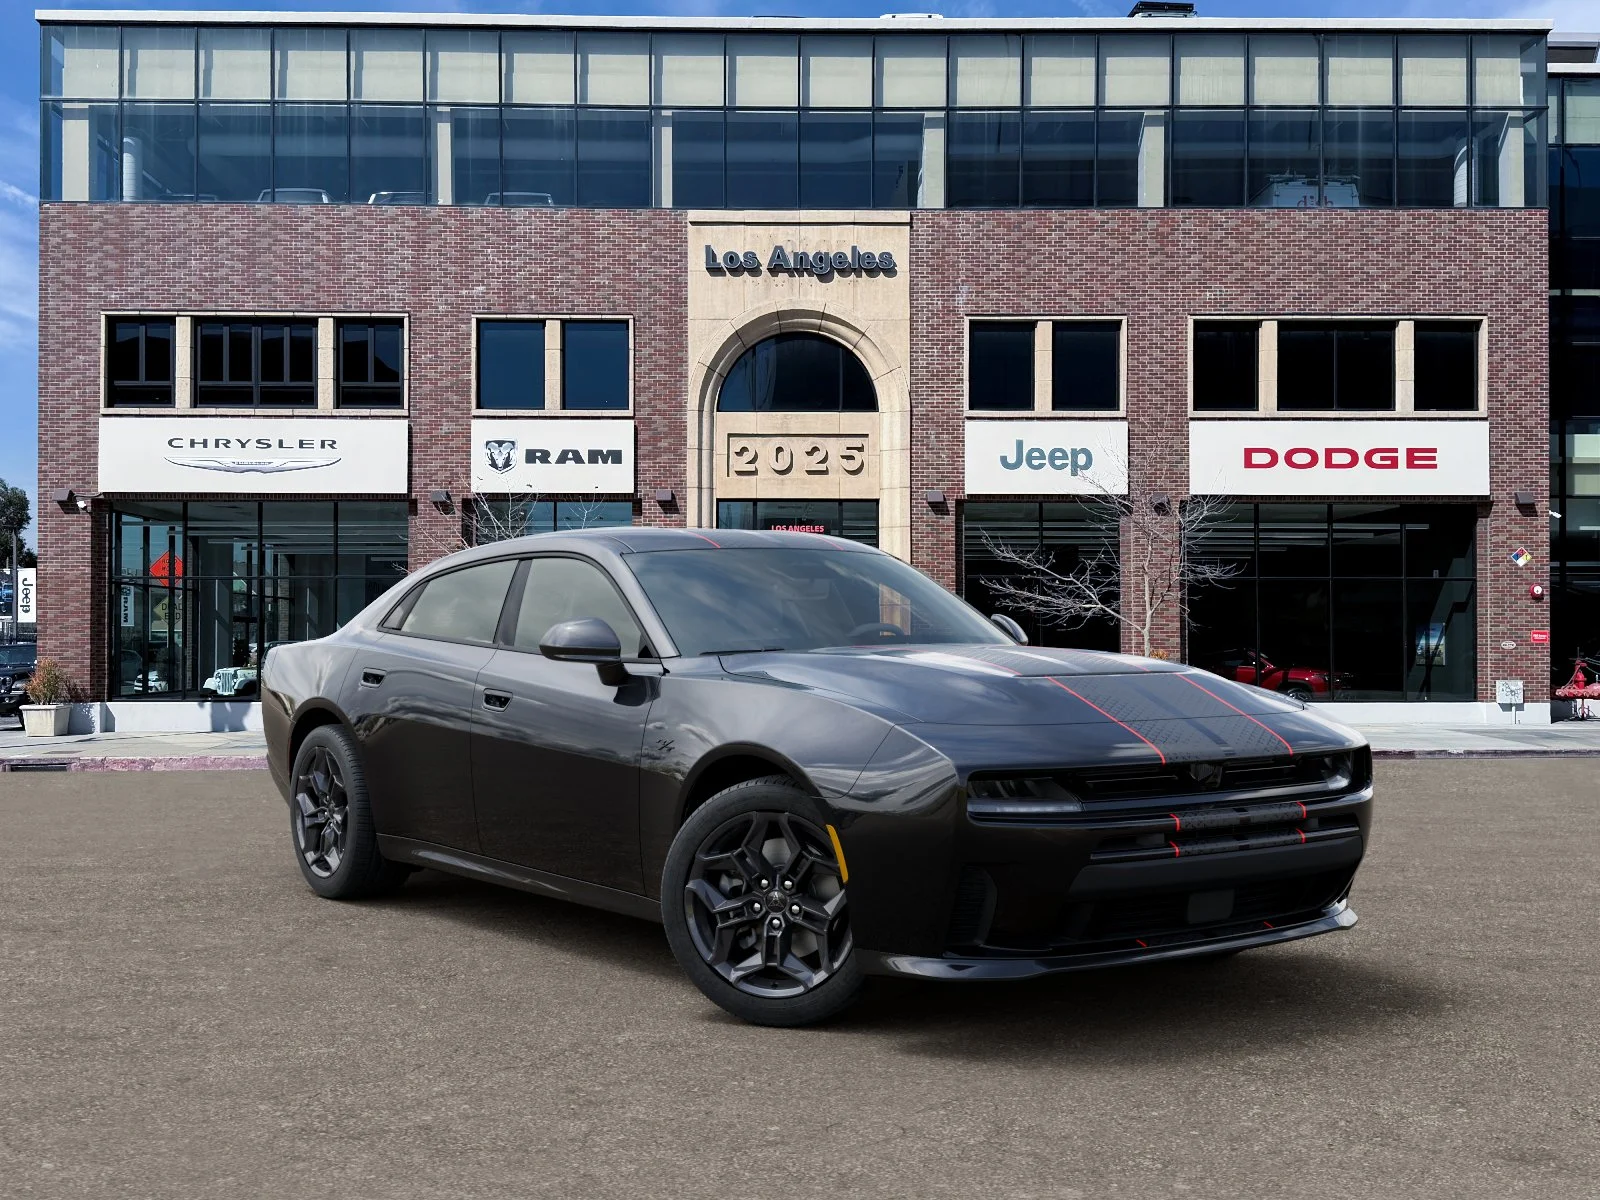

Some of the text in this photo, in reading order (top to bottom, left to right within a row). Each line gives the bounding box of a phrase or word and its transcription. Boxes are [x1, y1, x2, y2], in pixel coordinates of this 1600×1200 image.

[704, 244, 896, 276] Los Angeles
[167, 437, 338, 450] CHRYSLER
[525, 448, 623, 465] RAM
[733, 441, 864, 474] 2025
[1000, 439, 1093, 476] Jeep
[1243, 447, 1438, 470] DODGE
[20, 577, 34, 614] Jeep
[164, 612, 181, 620] ED
